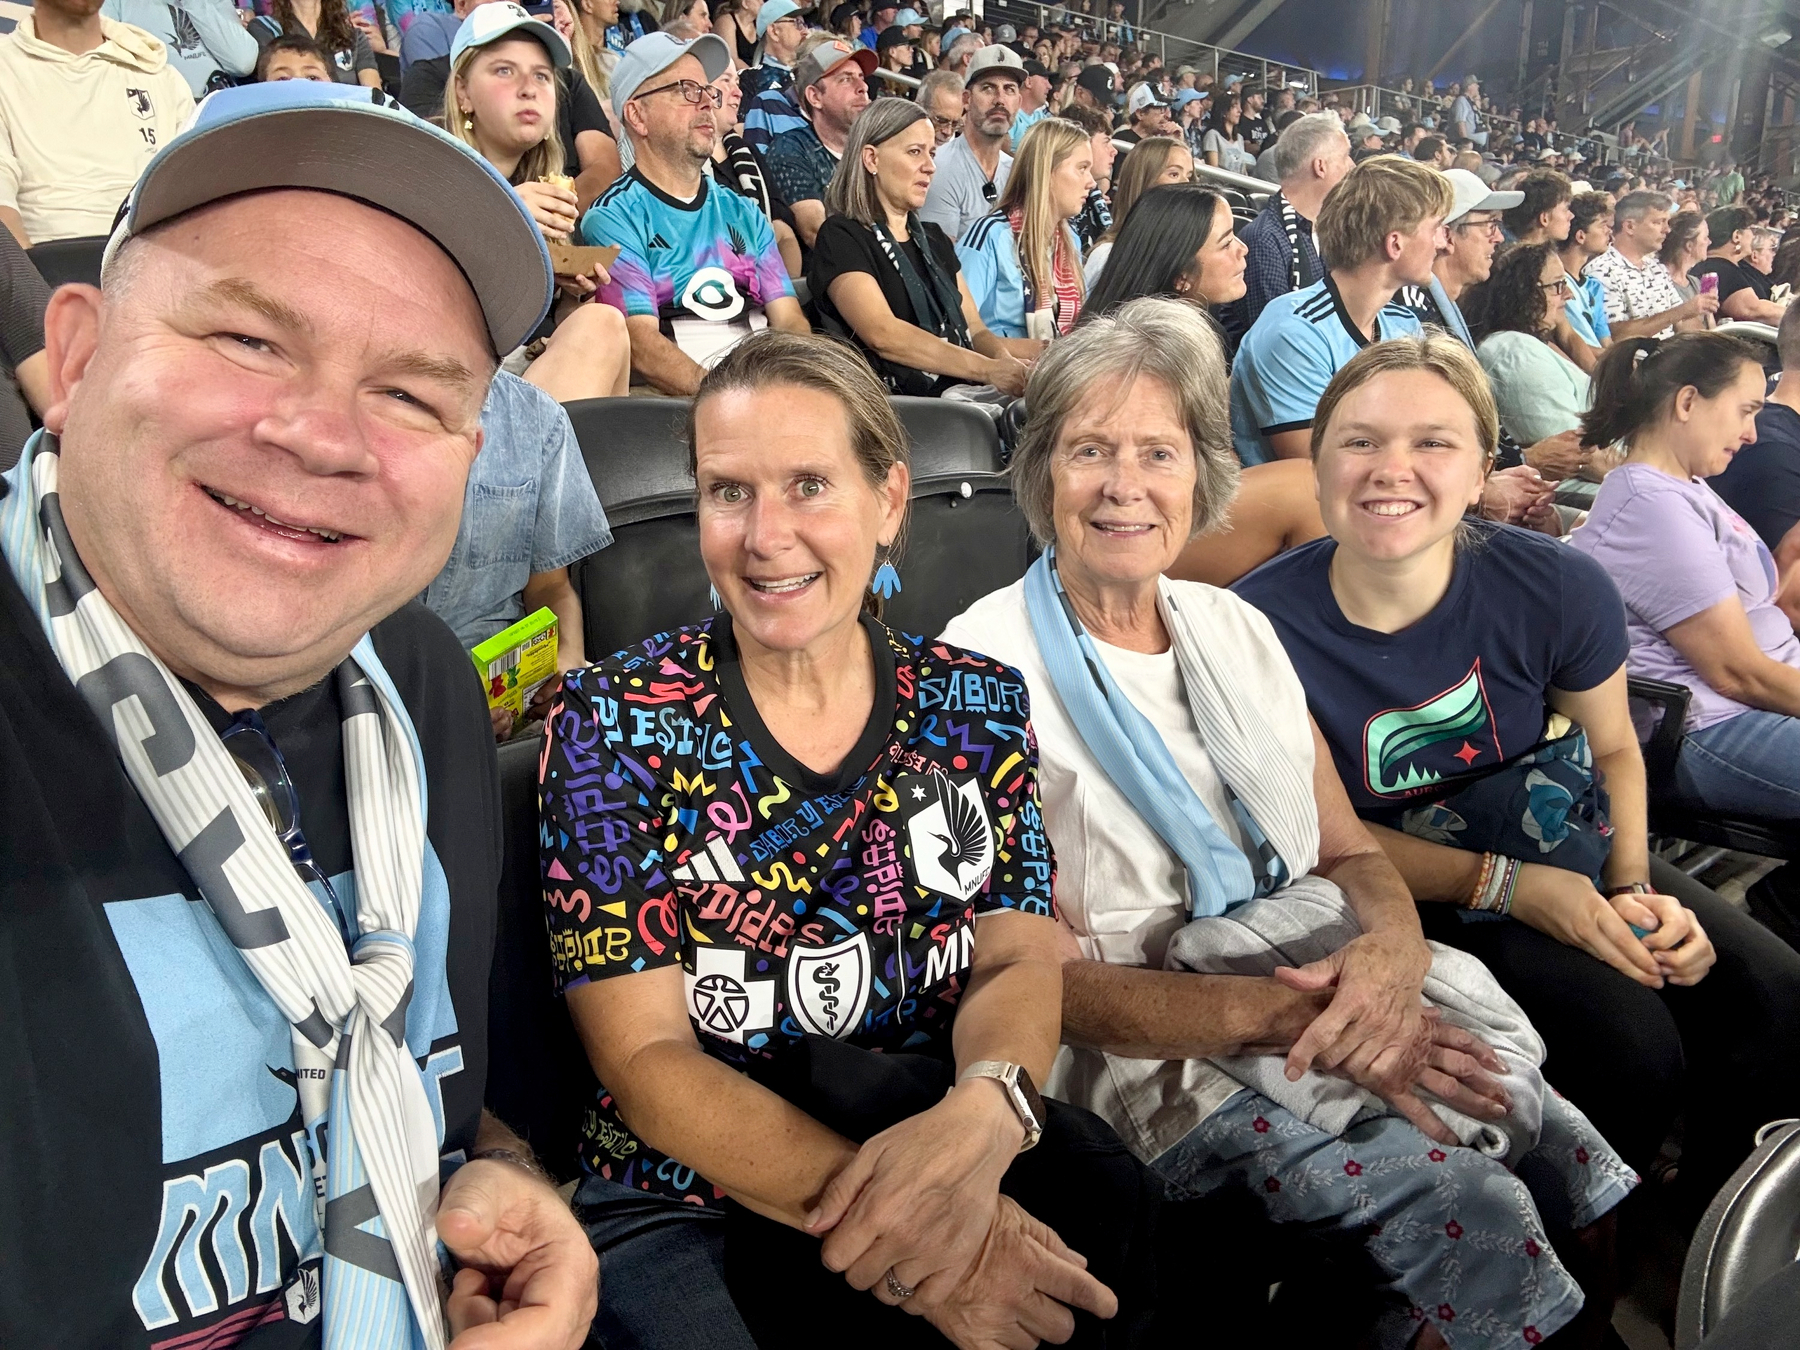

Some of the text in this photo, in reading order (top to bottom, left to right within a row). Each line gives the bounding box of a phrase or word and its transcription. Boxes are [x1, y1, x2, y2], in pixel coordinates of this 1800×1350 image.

[138, 127, 156, 145] 15
[918, 670, 1026, 717] SABOR
[750, 817, 811, 862] SABOR
[963, 866, 991, 896] MNUFC
